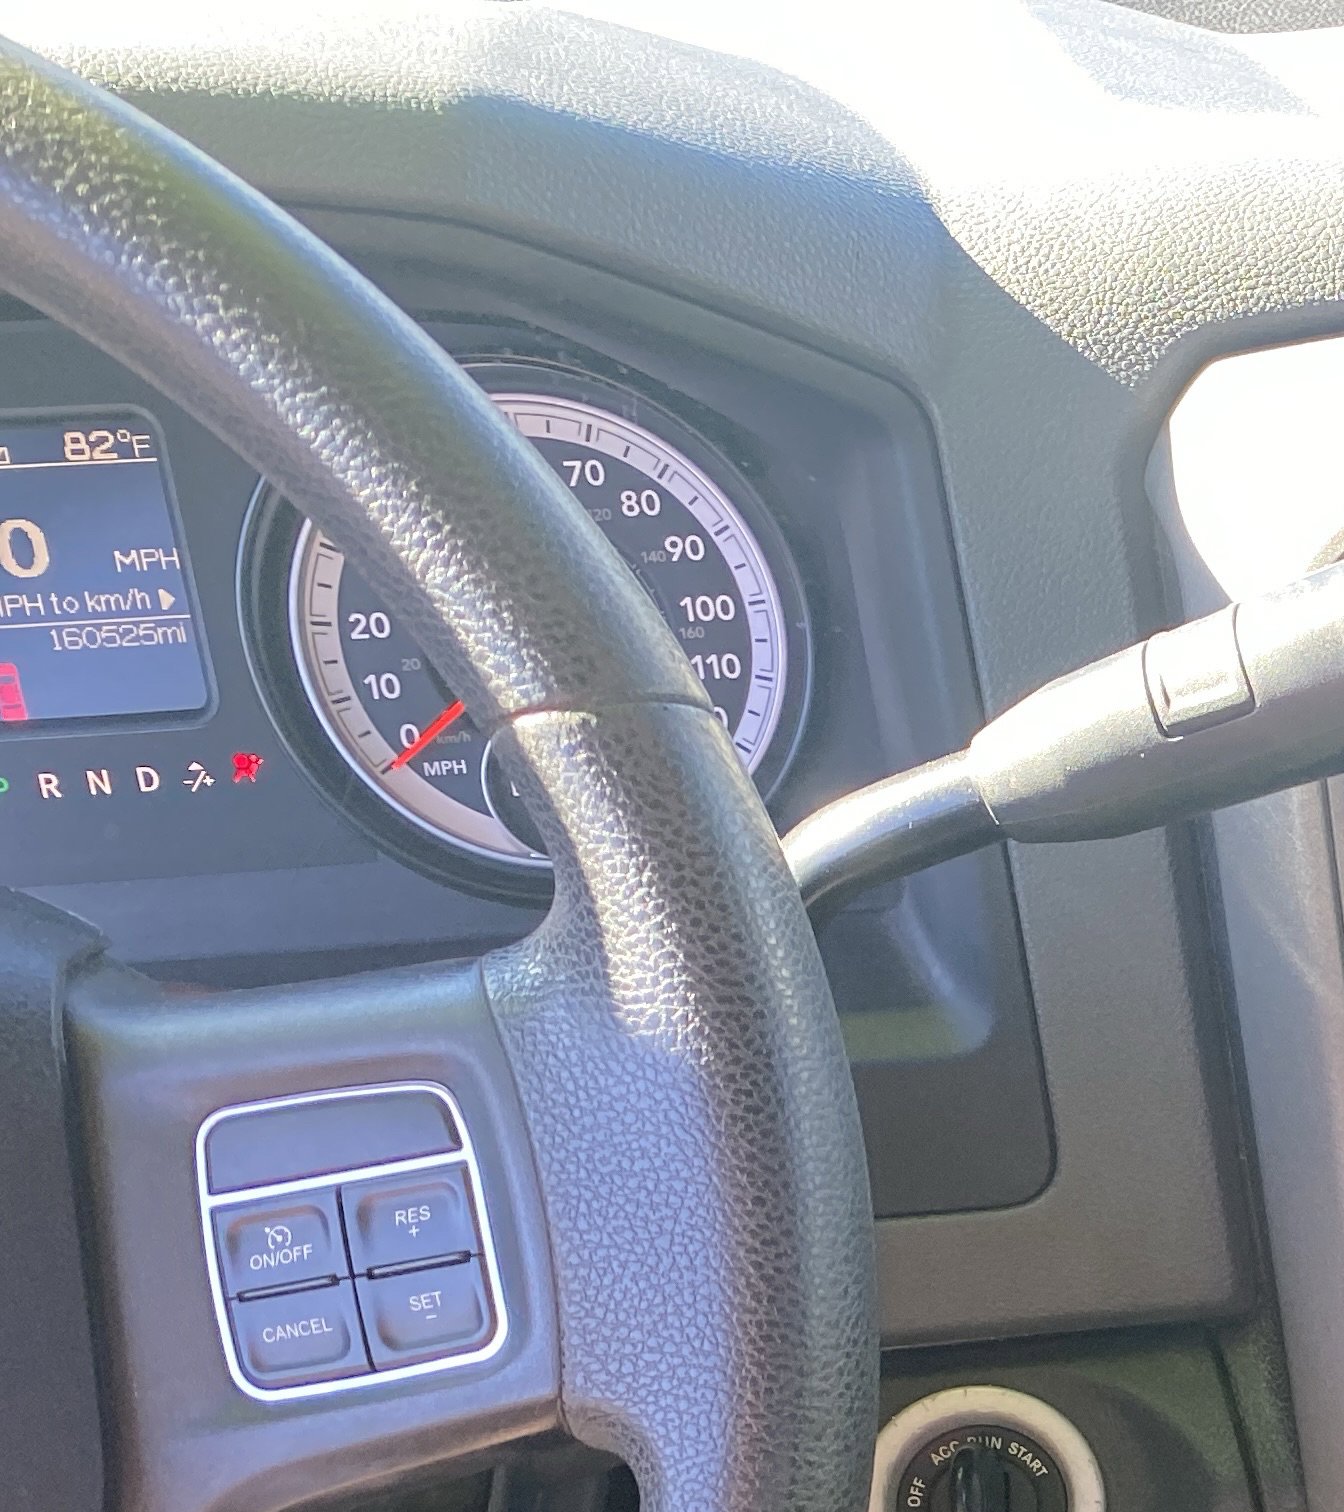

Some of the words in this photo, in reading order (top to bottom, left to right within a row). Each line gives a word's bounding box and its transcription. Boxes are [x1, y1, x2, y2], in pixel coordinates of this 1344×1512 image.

[562, 459, 605, 487] 70
[620, 489, 661, 517] 80
[0, 519, 49, 578] 0
[114, 548, 180, 572] MPH
[641, 551, 666, 563] 140
[664, 534, 705, 562] 90
[0, 594, 45, 617] PH
[50, 592, 79, 614] to
[84, 588, 152, 613] km/h
[679, 595, 736, 622] 100
[348, 612, 391, 640] 20
[679, 627, 705, 639] 160
[401, 658, 421, 672] 20
[691, 653, 741, 680] 110
[363, 673, 401, 700] 10
[400, 724, 420, 749] 0
[422, 759, 468, 776] MPH
[38, 773, 63, 799] R
[86, 769, 113, 796] N
[136, 766, 161, 792] D
[394, 1205, 431, 1227] RES
[249, 1243, 314, 1271] ON/OFF
[409, 1290, 442, 1312] SET
[262, 1317, 333, 1344] CANCEL
[1008, 1441, 1049, 1477] START
[907, 1476, 926, 1508] OFF
